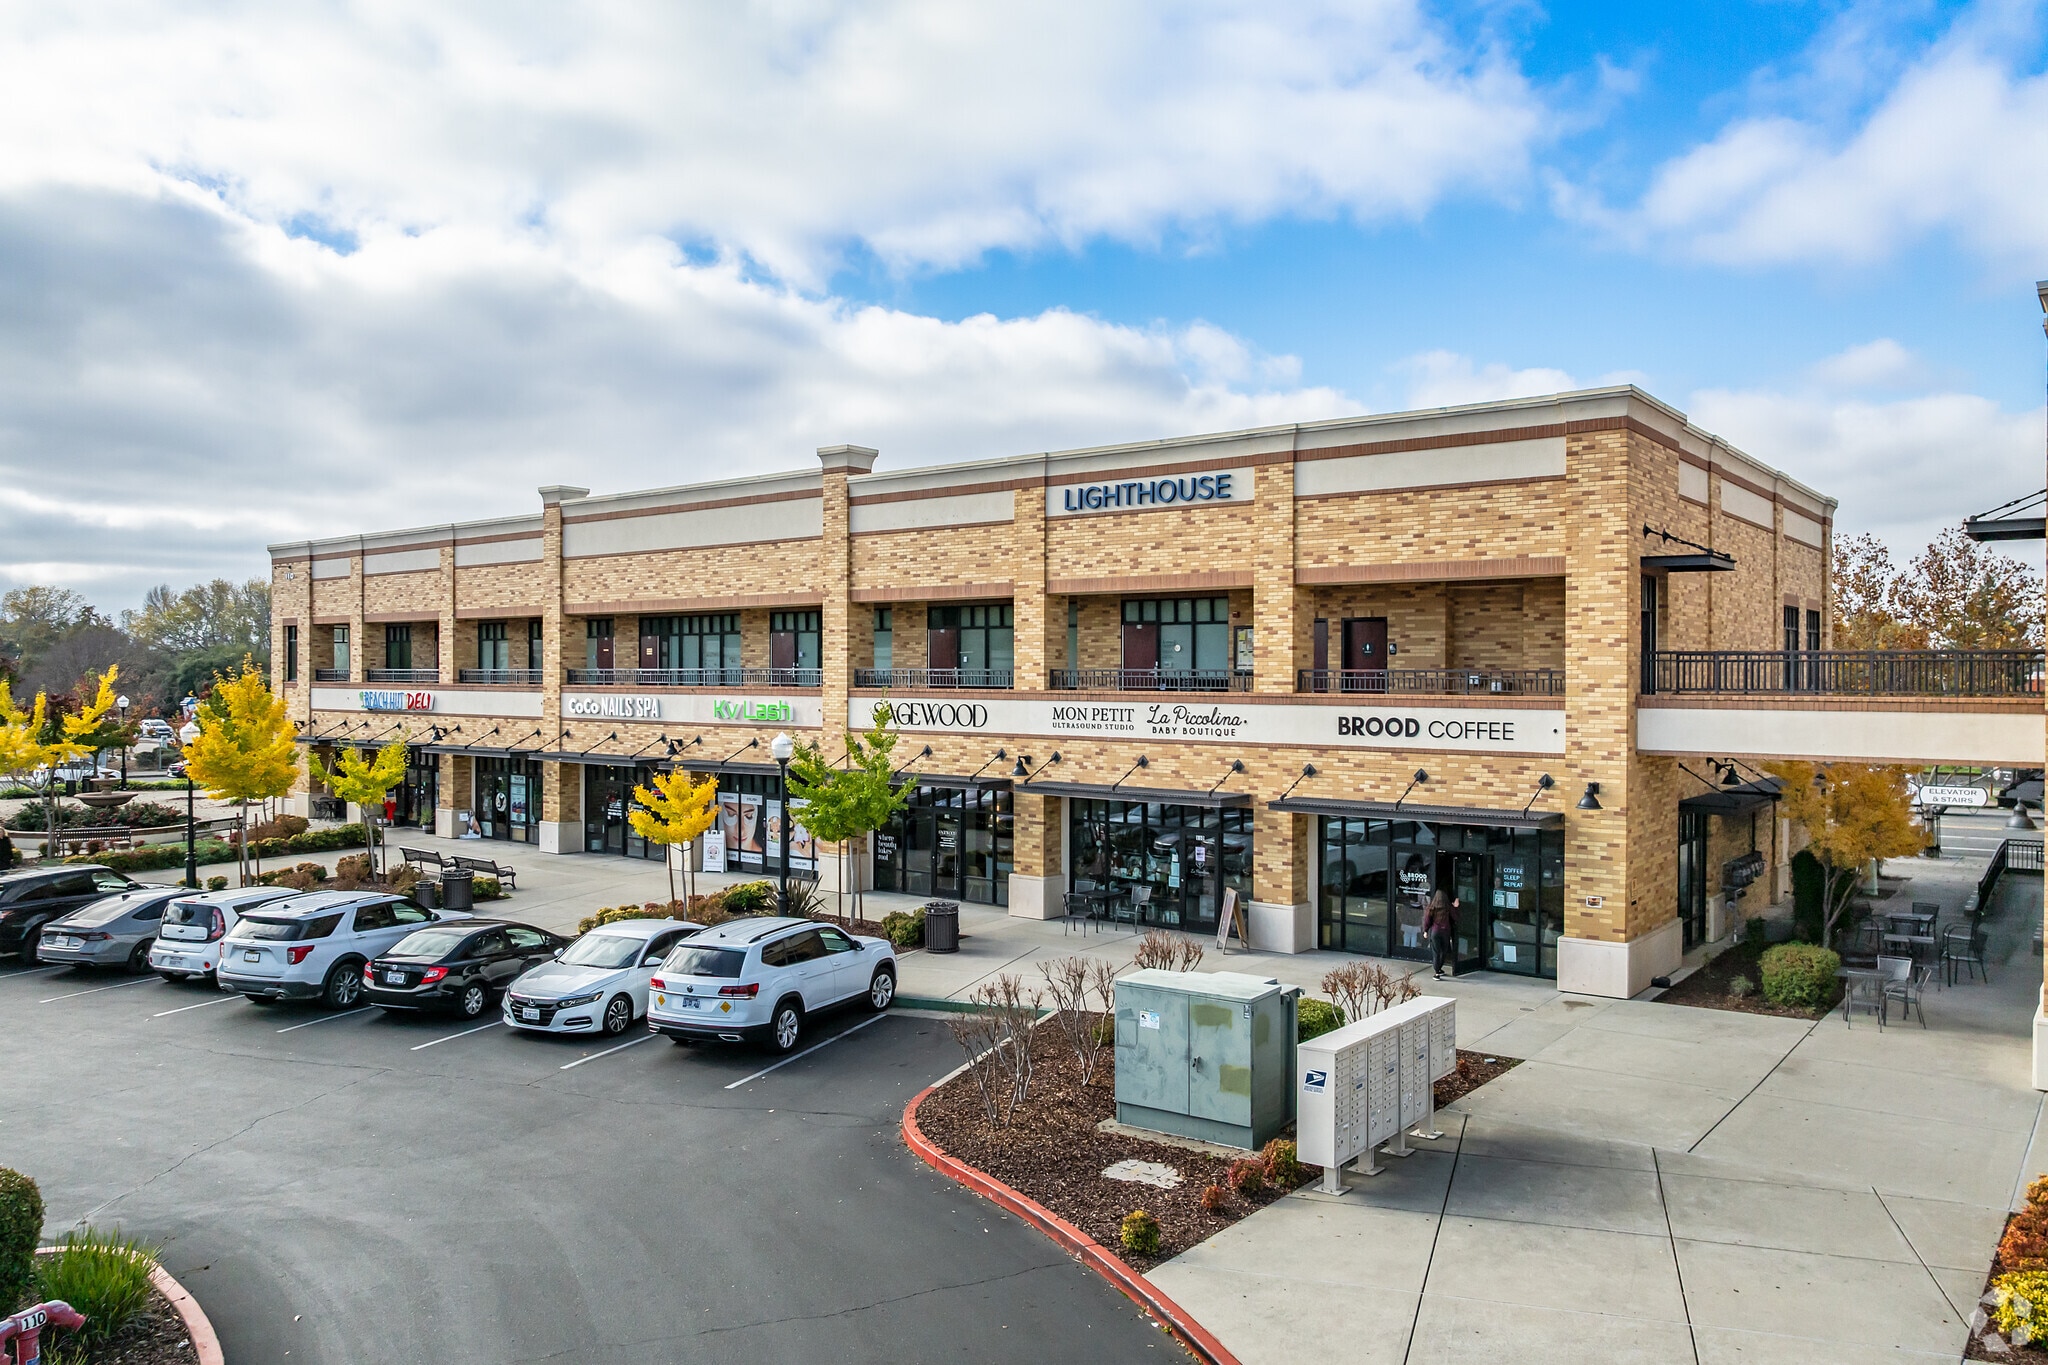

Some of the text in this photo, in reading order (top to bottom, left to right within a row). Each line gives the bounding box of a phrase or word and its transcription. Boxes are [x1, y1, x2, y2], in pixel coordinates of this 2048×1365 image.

[1065, 474, 1231, 511] LIGHTHOUSE
[364, 691, 431, 710] BEACH HUT DELI
[568, 697, 660, 718] CoCo NAILS SPA
[713, 699, 791, 721] Kv Lash
[1052, 706, 1135, 722] MON PETIT
[1146, 704, 1242, 726] La Piccolina
[1052, 722, 1135, 731] ULTRASOUND STUDIO
[1152, 726, 1236, 737] BABY BOUTIQUE
[1338, 716, 1515, 741] BROOD COFFEE
[1928, 788, 1977, 796] ELEVATOR
[1941, 796, 1974, 804] STAIRS
[1503, 867, 1524, 875] COFFEE
[24, 1312, 46, 1330] 110
